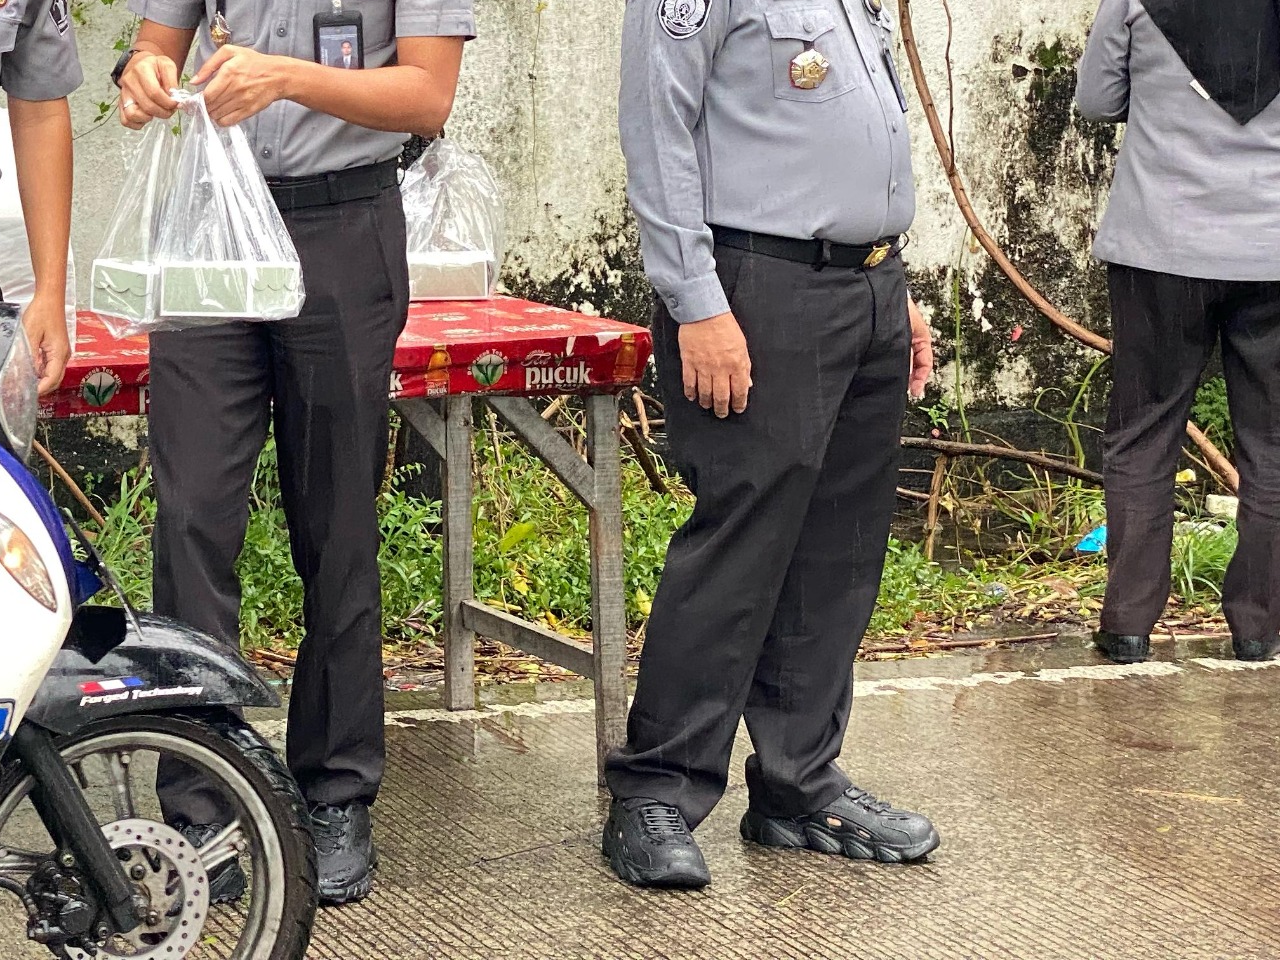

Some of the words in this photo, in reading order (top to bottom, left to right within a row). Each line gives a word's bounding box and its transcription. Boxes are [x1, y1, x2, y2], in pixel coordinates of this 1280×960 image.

[525, 360, 591, 391] pucuk
[80, 691, 129, 706] Forged
[132, 686, 203, 700] Technology
